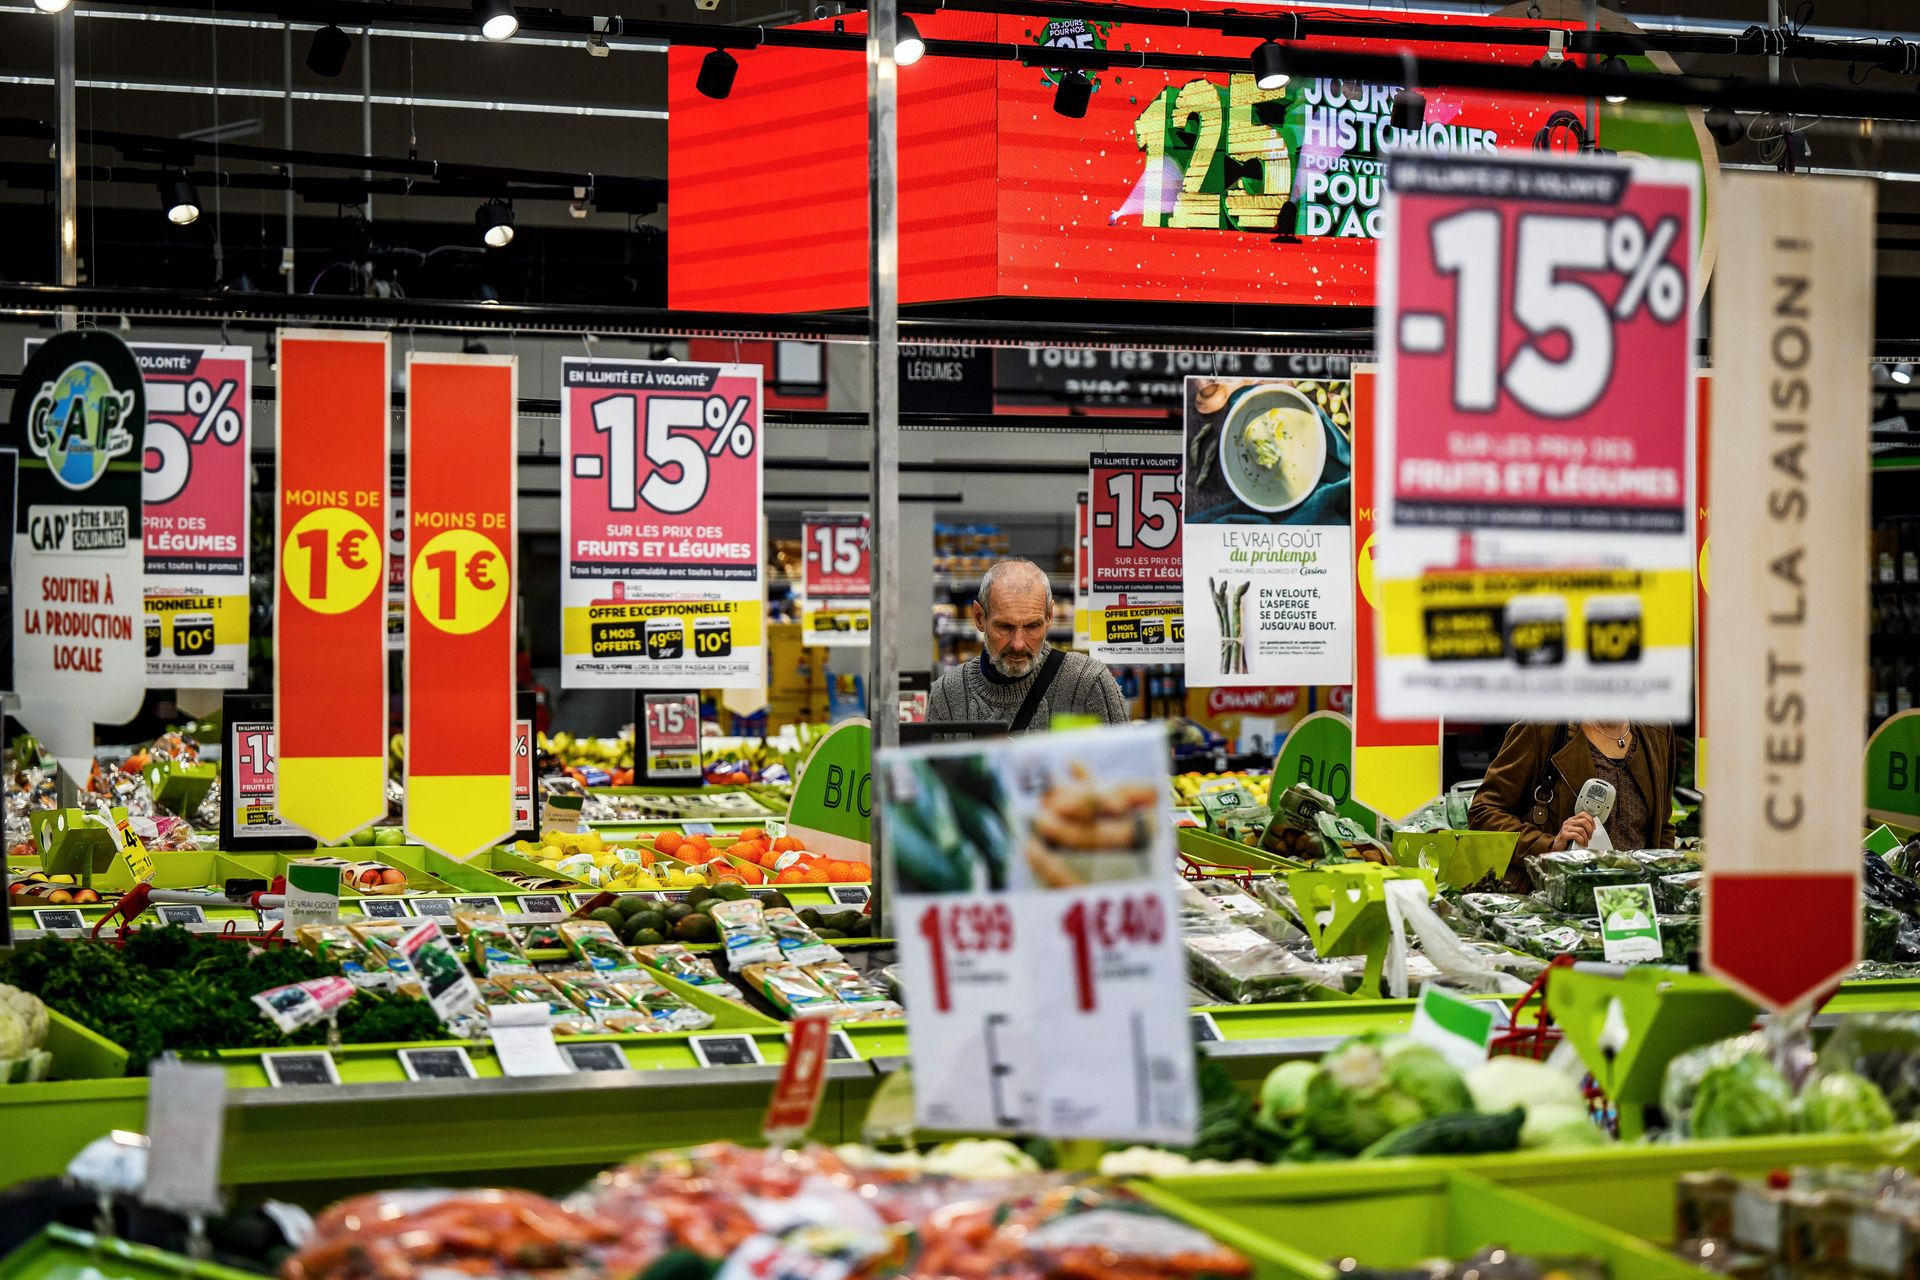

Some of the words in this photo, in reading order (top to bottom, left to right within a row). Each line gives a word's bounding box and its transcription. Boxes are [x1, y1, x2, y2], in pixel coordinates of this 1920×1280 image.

[1049, 27, 1070, 37] POUR
[1070, 25, 1085, 34] NOS
[1060, 19, 1084, 27] JOURS
[1135, 73, 1291, 229] 125
[1306, 154, 1350, 172] POUR
[1307, 172, 1388, 206] POU
[1399, 207, 1686, 419] -15%
[569, 370, 583, 382] EN
[586, 370, 629, 384] ILLIMITÉ
[631, 373, 644, 384] ET
[645, 371, 654, 384] À
[907, 359, 963, 381] LÉGUMES
[1767, 275, 1812, 524] SAISON
[574, 394, 755, 514] -15%
[1104, 457, 1129, 465] ILLIMITÉ
[1140, 458, 1145, 466] À
[1401, 457, 1500, 495] FRUITS
[1504, 460, 1541, 495] ET
[1545, 459, 1679, 498] LÉGUMES
[285, 490, 349, 506] MOINS
[354, 491, 380, 507] DE
[72, 508, 100, 528] D'ÊTRE
[103, 509, 125, 526] PLUS
[178, 518, 206, 530] DES
[414, 511, 476, 528] MOINS
[482, 512, 506, 528] DE
[75, 531, 124, 548] SOLIDAIRES
[607, 524, 633, 537] SUR
[635, 525, 660, 537] LES
[662, 525, 693, 538] PRIX
[696, 526, 723, 538] DES
[1223, 532, 1238, 547] LE
[1242, 532, 1274, 547] VRAI
[1278, 529, 1322, 548] GOÛT
[147, 531, 237, 551] LÉGUMES
[577, 540, 639, 557] FRUITS
[642, 541, 665, 557] ET
[668, 539, 751, 559] LÉGUMES
[296, 529, 370, 600] 1€
[1115, 557, 1132, 565] SUR
[1133, 557, 1149, 565] LES
[1150, 557, 1168, 565] PRIX
[1230, 547, 1248, 562] du
[1250, 547, 1317, 567] printemps
[572, 566, 590, 575] Tous
[591, 566, 602, 575] les
[603, 567, 620, 576] jours
[622, 567, 629, 575] et
[631, 567, 667, 576] cumulable
[688, 568, 711, 577] toutes
[712, 569, 723, 577] les
[725, 570, 752, 578] promos
[1097, 568, 1136, 577] FRUITS
[1138, 568, 1152, 577] ET
[1299, 566, 1327, 576] Casino
[42, 576, 99, 604] SOUTIEN
[104, 573, 114, 605] À
[425, 550, 497, 620] 1€
[1260, 589, 1272, 598] EN
[1275, 588, 1321, 599] VELOUTÉ,
[1767, 546, 1806, 627] LA
[589, 607, 627, 618] OFFRE
[629, 602, 731, 617] EXCEPTIONNELLE
[1259, 600, 1309, 608] L'ASPERGE
[1104, 609, 1128, 618] OFFRE
[1260, 611, 1271, 619] SE
[1274, 609, 1317, 619] DÉGUSTE
[25, 609, 41, 634] LA
[46, 610, 132, 640] PRODUCTION
[1260, 622, 1306, 631] JUSQU'AU
[1309, 622, 1336, 630] BOUT.
[177, 628, 213, 651] 10€
[600, 630, 607, 640] 6
[609, 629, 636, 639] MOIS
[697, 631, 730, 652] 10€
[1108, 632, 1138, 640] OFFERTS
[594, 640, 641, 652] OFFERTS
[54, 645, 103, 672] LOCALE
[1766, 649, 1806, 832] C'EST
[314, 900, 337, 909] GOÛT
